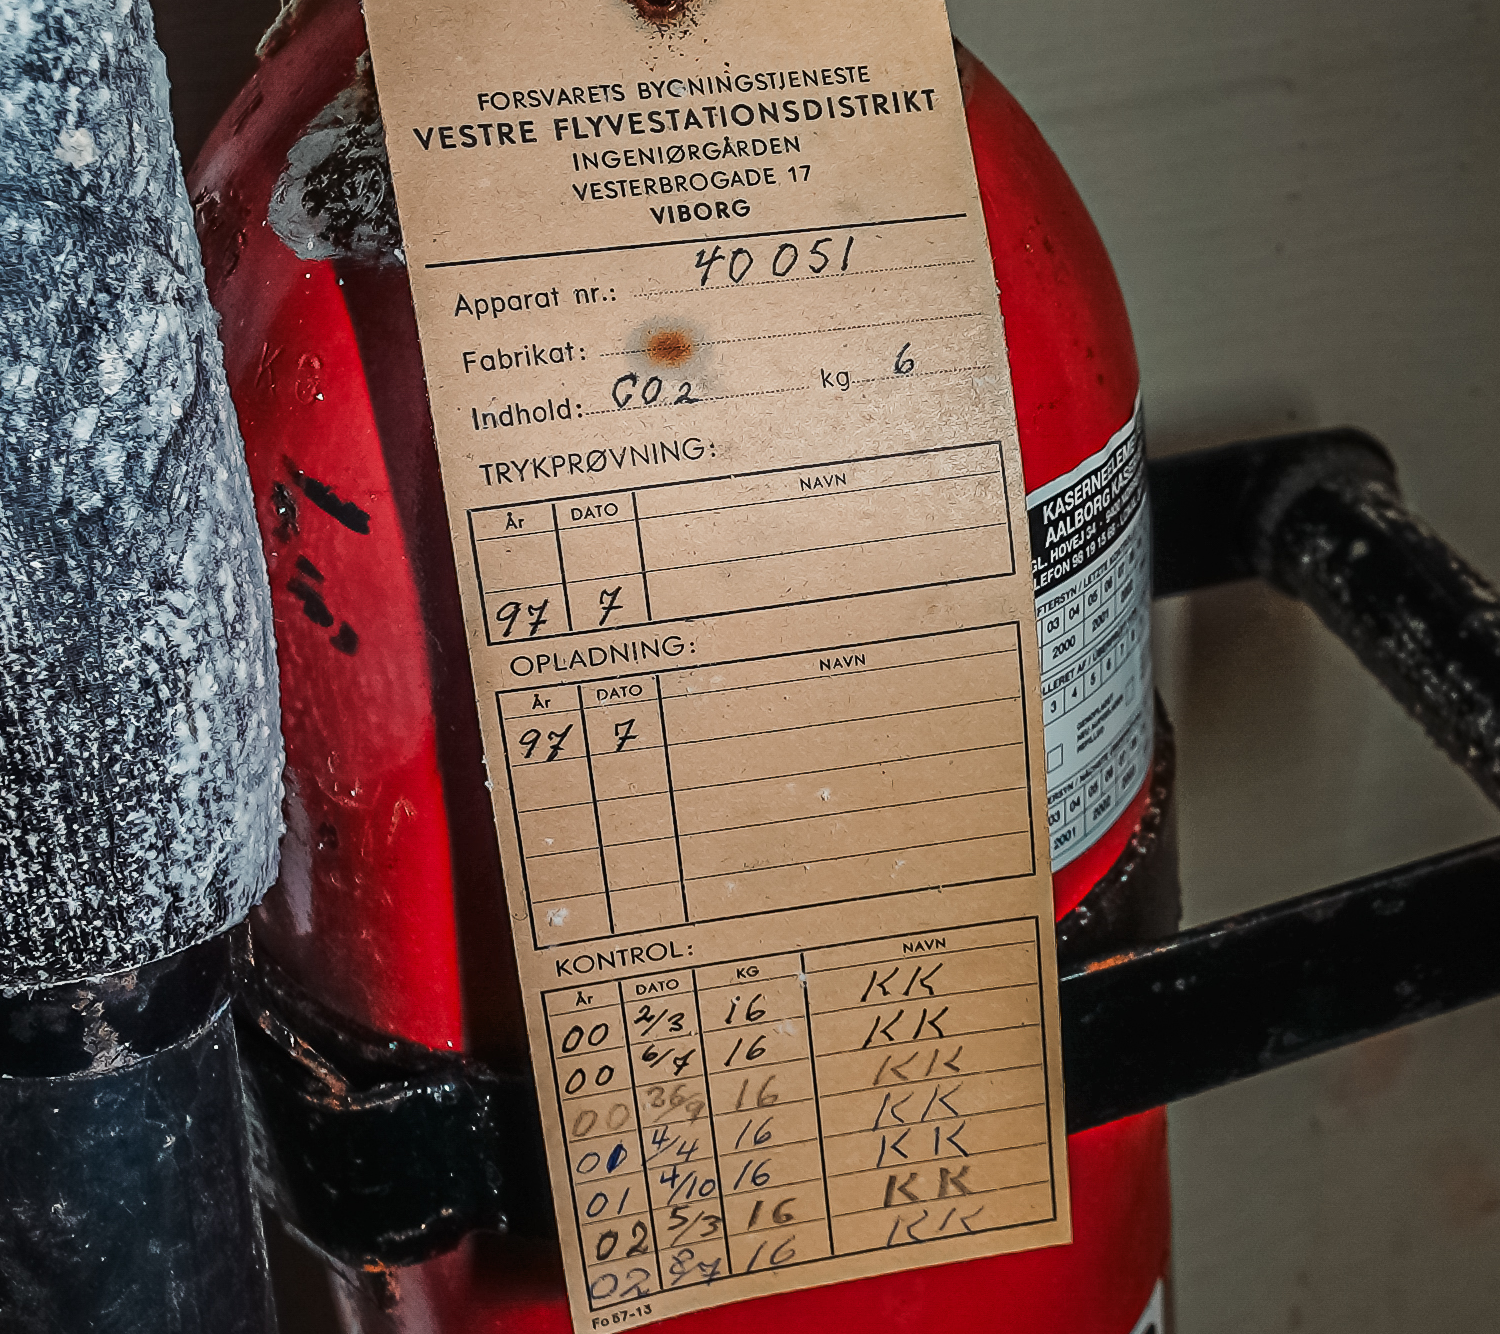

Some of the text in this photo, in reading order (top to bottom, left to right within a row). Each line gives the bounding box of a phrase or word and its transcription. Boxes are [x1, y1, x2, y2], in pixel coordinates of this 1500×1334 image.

[477, 83, 625, 111] FORSVARETS
[413, 88, 937, 151] VESTRE FLYVESTATIONSDISTRIKT
[573, 134, 801, 172] INGENIØRGÅRDEN
[572, 164, 812, 202] VESTERBROGADE 17
[650, 199, 751, 226] VIBORG
[454, 287, 559, 320] Apparat
[462, 341, 587, 374] Fabrikat:
[893, 343, 915, 376] 6
[820, 366, 851, 392] kg
[472, 395, 583, 430] Indhold:
[479, 438, 716, 488] TRYKPRØVNING:
[799, 472, 848, 492] NAVN
[505, 511, 525, 531] År
[571, 500, 619, 522] DATO
[1045, 487, 1111, 548] AALBORG
[1034, 556, 1070, 591] LEFON
[598, 585, 624, 625] 7
[1037, 585, 1077, 616] FTERSYN
[496, 598, 549, 638] 97
[510, 636, 696, 678] OPLADNING:
[819, 653, 867, 672] NAVN
[1052, 635, 1076, 660] 2000
[532, 692, 551, 712] År
[596, 682, 643, 702] DATO
[1072, 686, 1077, 698] 4
[518, 723, 574, 761] 97
[613, 719, 638, 752] 7
[555, 939, 693, 977] KONTROL:
[902, 937, 946, 954] NAVN
[636, 979, 679, 995] DATO
[736, 966, 760, 978] KG
[576, 991, 593, 1006] År
[562, 1022, 609, 1053] 00
[565, 1065, 614, 1094] 00
[724, 1035, 766, 1067] 16
[735, 1075, 779, 1111] 16
[735, 1117, 774, 1149] 16
[586, 1187, 630, 1218] 01
[734, 1158, 772, 1190] 16
[596, 1220, 648, 1261] 02
[748, 1198, 796, 1231] 16
[747, 1235, 795, 1272] 16
